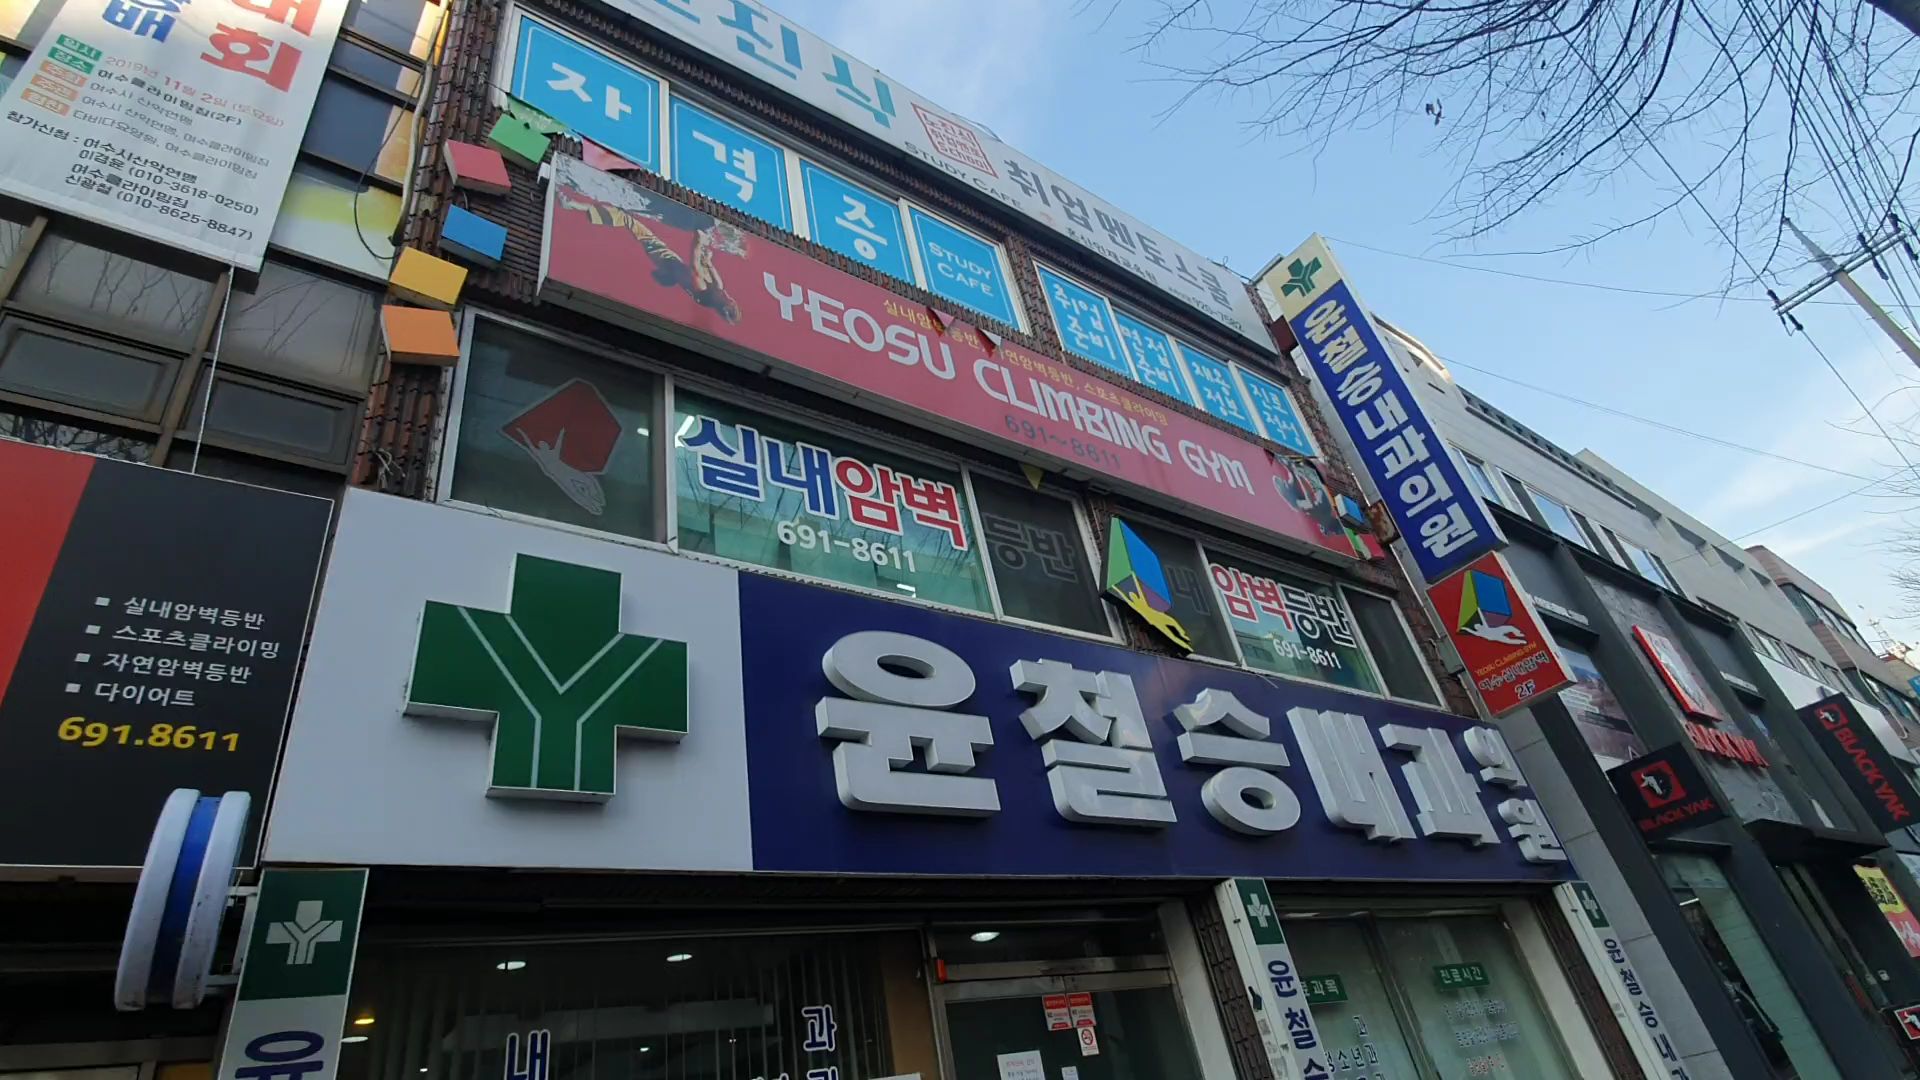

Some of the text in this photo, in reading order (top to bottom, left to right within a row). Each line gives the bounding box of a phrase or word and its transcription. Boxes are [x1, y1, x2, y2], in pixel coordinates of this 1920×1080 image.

[81, 95, 122, 112] 여수시
[89, 81, 194, 126] 여수시 산악연맹
[163, 76, 197, 97] 11월
[201, 92, 228, 109] 2일
[6, 109, 70, 141] 참가신청
[83, 137, 199, 185] 여수시산악연맹
[905, 141, 1023, 210] STUDY CAFE
[72, 162, 190, 210] 여수클라이밍짐
[128, 165, 260, 217] (010-3618-0250)
[116, 189, 254, 241] (010-8625-8847)
[1003, 159, 1234, 311] 취업멘토스쿨
[928, 241, 993, 279] STUDY
[937, 262, 995, 299] CAFE
[1052, 282, 1106, 333] 취업
[1067, 313, 1117, 361] 준비
[763, 270, 1255, 496] YEOSU CLIMBING GYM
[995, 345, 1080, 392] 연암벽등반,
[679, 414, 1080, 585] 실내암벽 등반
[776, 519, 917, 573] 691-8611
[123, 596, 266, 631] 실내암벽등반
[1207, 562, 1358, 649] 암벽등반
[111, 624, 281, 660] 스포츠클라이밍
[1272, 638, 1342, 670] 691-8611
[102, 652, 253, 685] 자연암벽등반
[1514, 678, 1536, 699] 2F
[93, 681, 197, 707] 다이어트
[57, 716, 240, 752] 691.8611
[1439, 965, 1484, 985] 진료시간
[801, 1004, 838, 1051] 과
